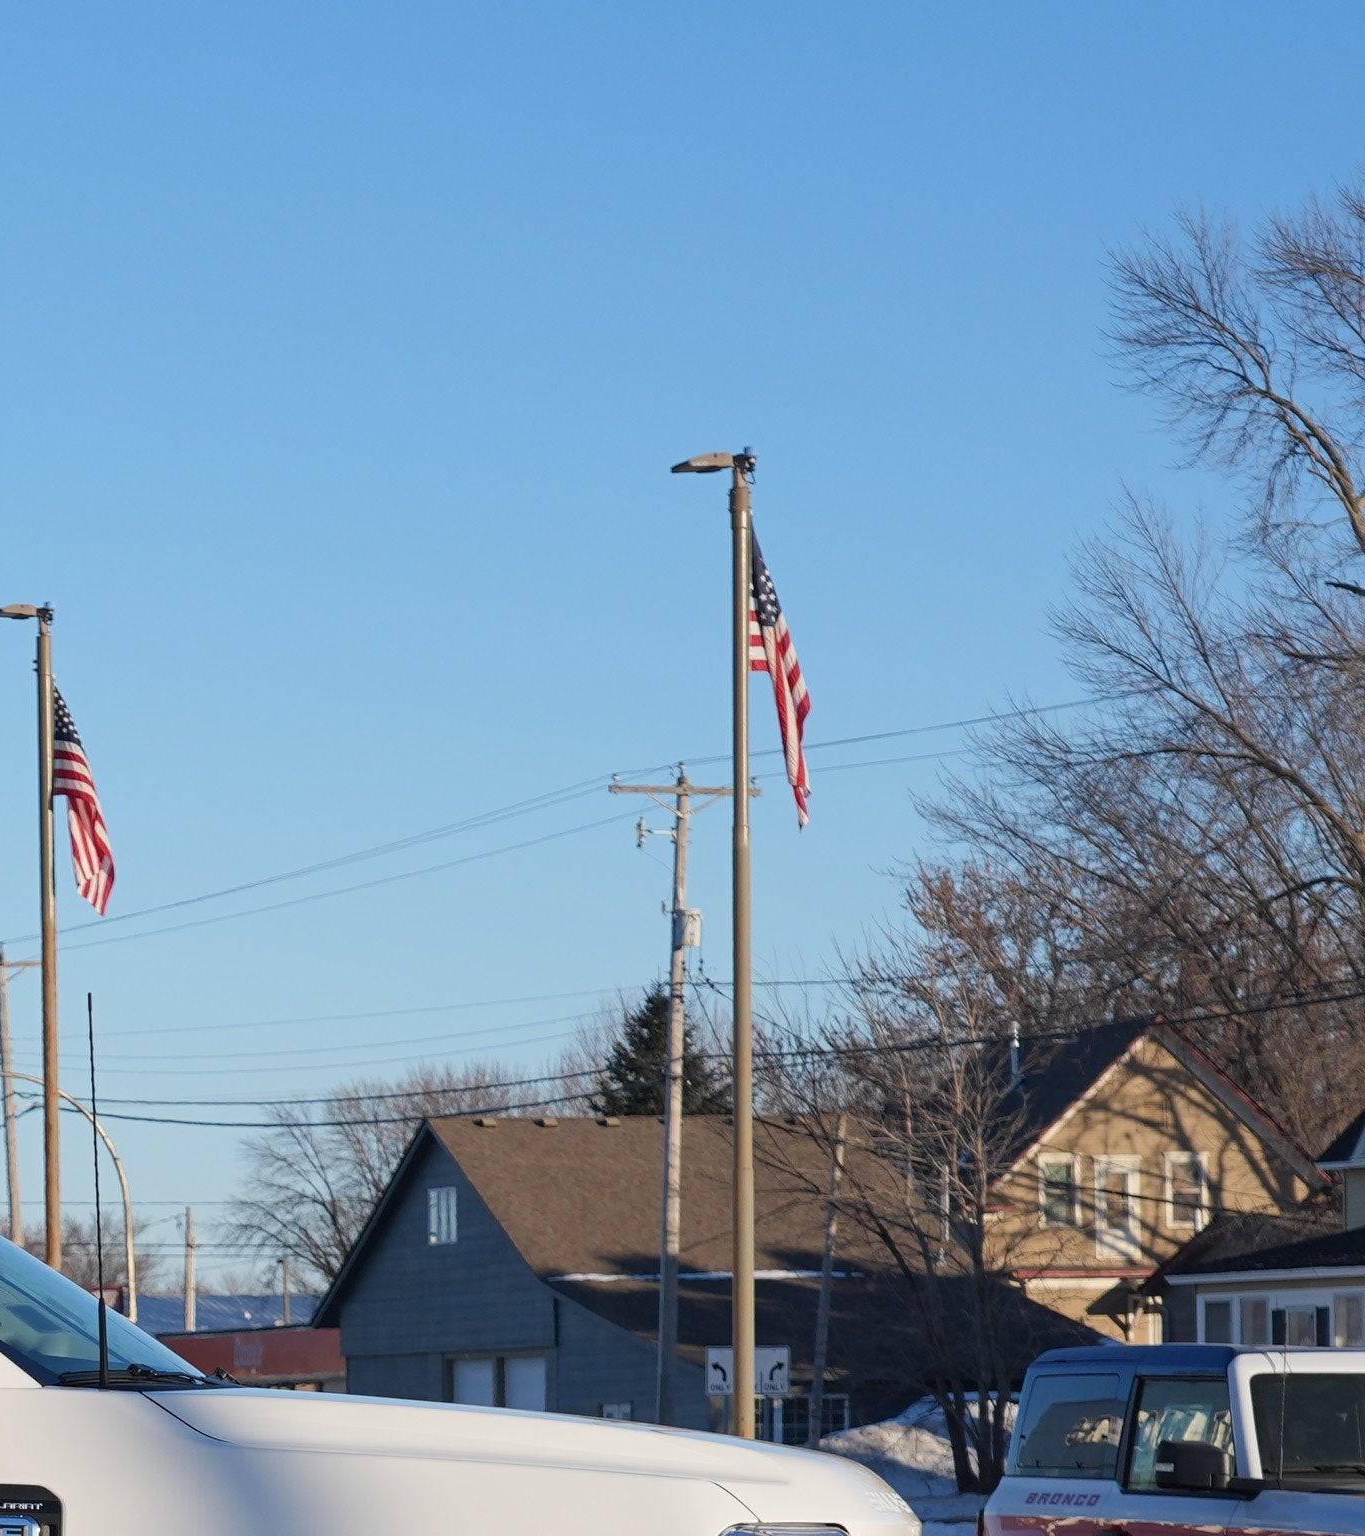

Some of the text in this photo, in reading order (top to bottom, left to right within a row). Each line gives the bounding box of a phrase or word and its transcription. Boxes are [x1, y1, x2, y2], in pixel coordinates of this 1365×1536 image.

[710, 1382, 731, 1392] ONLY
[764, 1382, 786, 1392] ONLY
[1025, 1492, 1101, 1507] BRONCO
